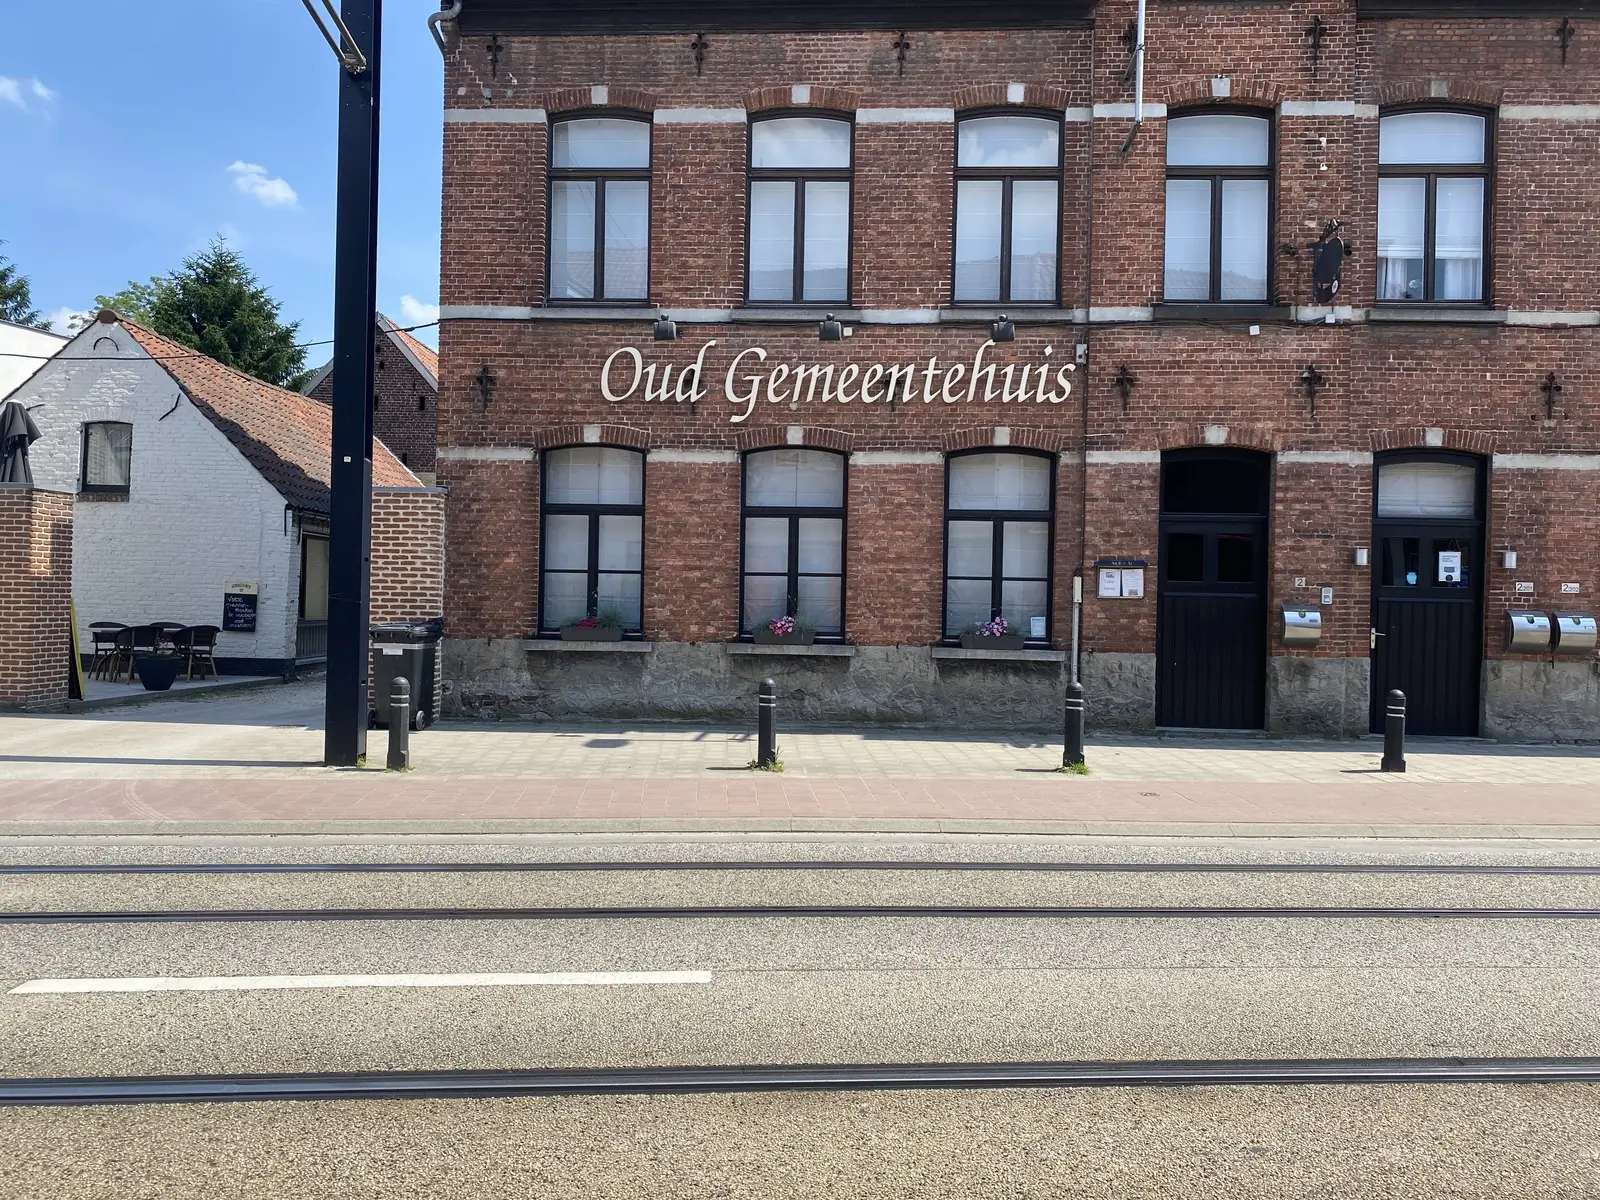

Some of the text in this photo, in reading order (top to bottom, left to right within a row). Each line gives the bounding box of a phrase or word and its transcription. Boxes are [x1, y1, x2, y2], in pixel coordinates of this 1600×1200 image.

[600, 339, 1076, 423] Oud Gemeentehuis
[1297, 578, 1304, 587] 2
[1563, 584, 1579, 593] 2/202
